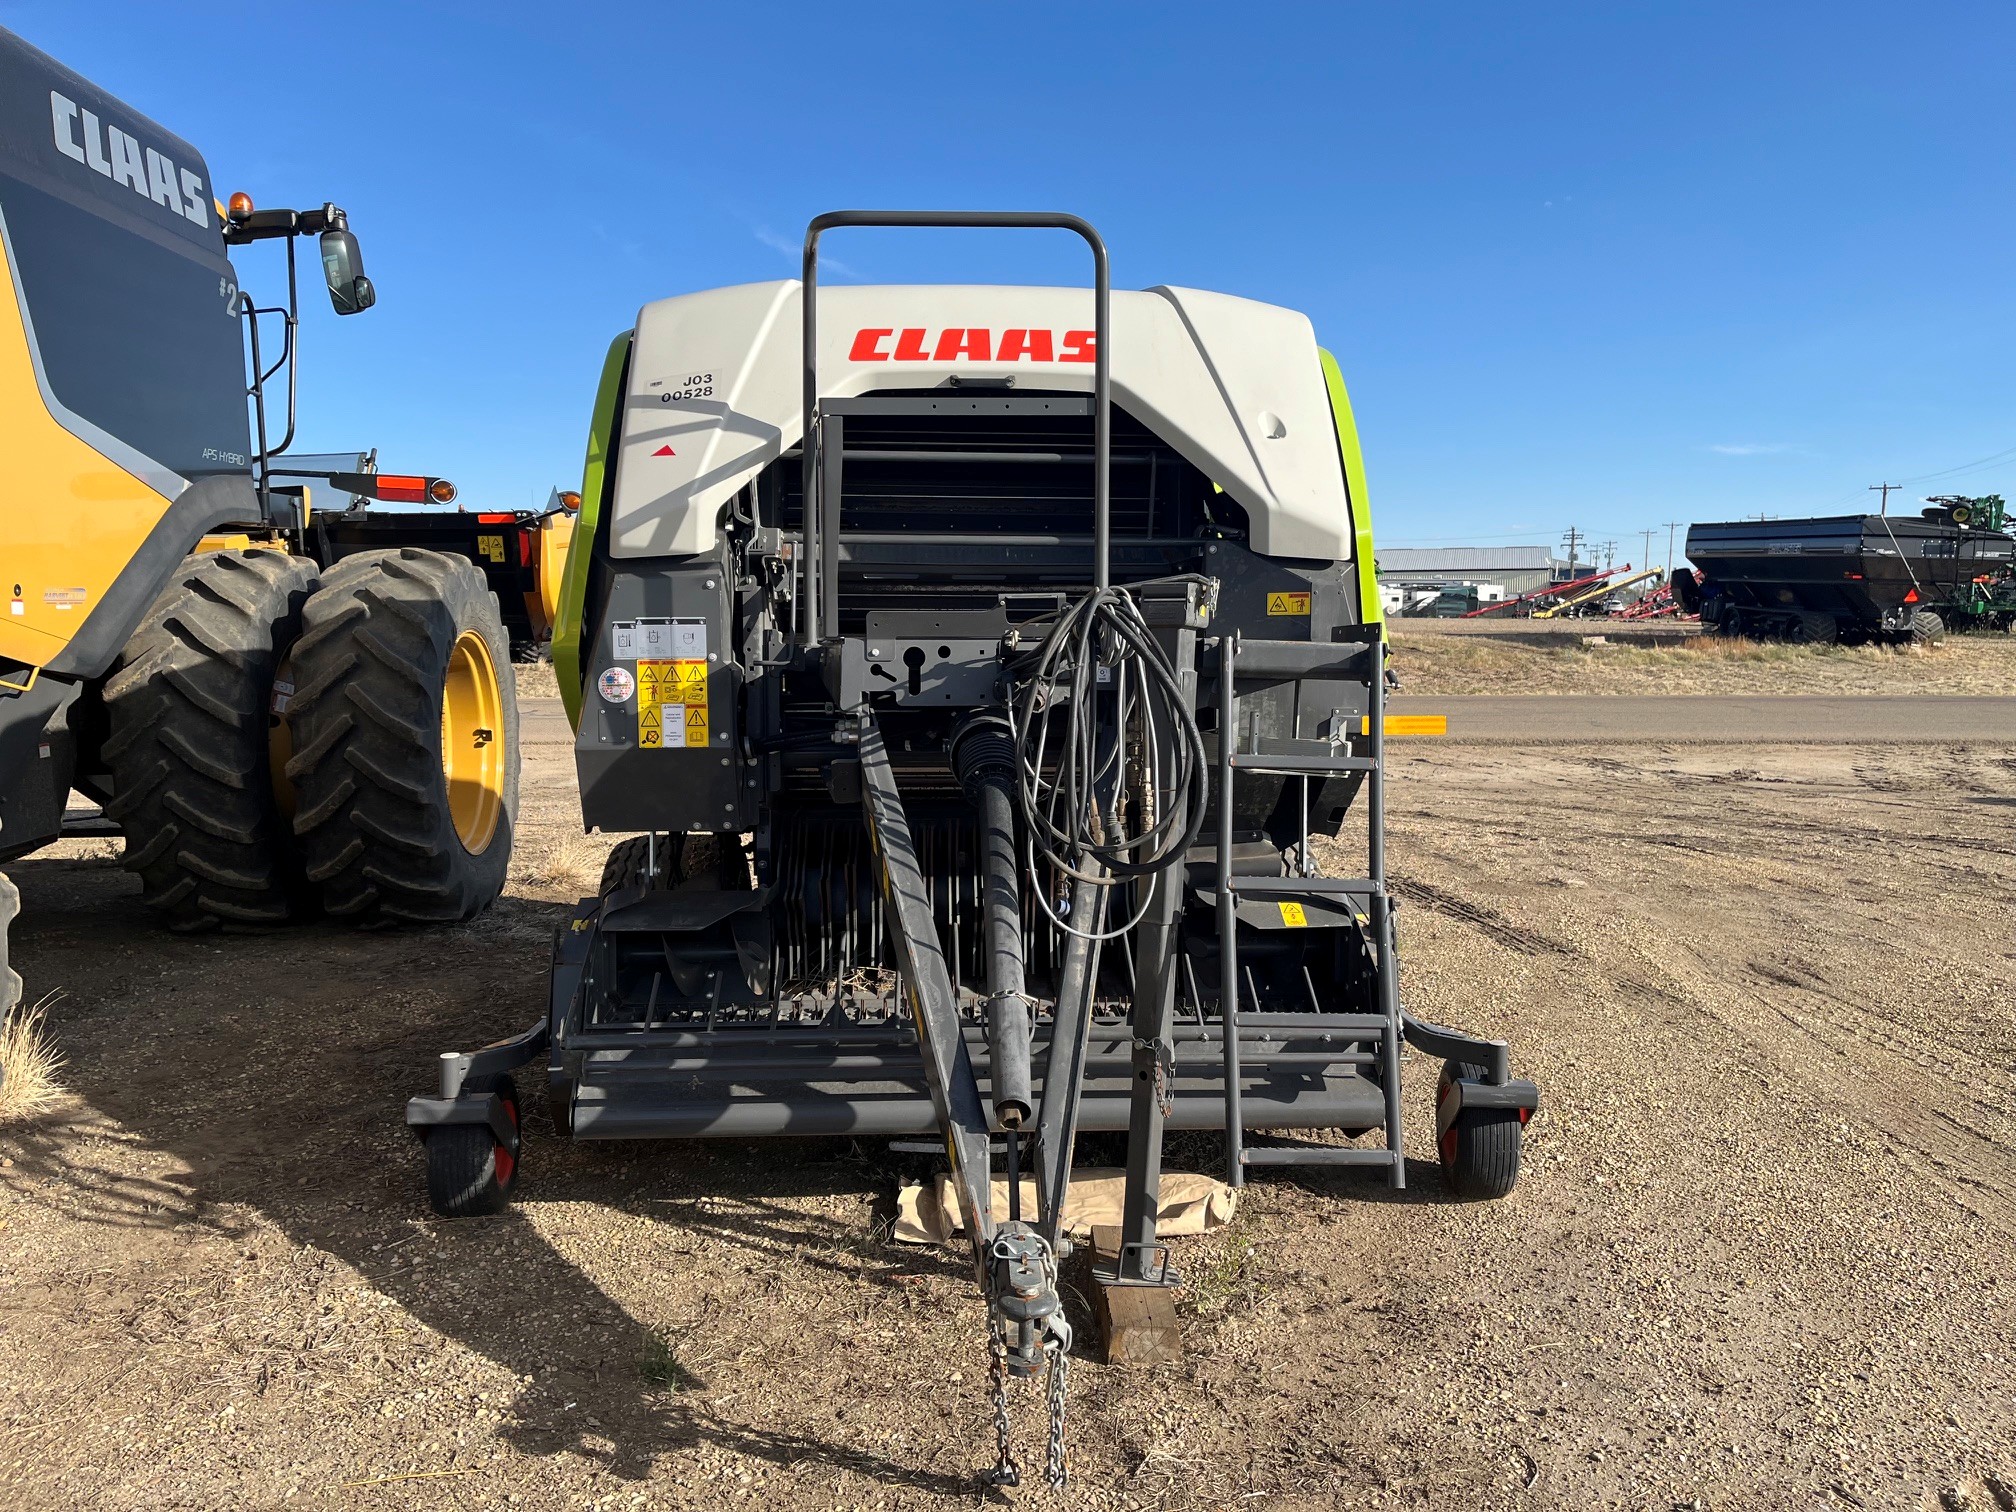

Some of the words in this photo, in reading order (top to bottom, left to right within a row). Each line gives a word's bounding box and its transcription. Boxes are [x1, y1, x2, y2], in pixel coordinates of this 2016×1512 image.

[51, 90, 208, 229] CLAAS
[219, 277, 236, 318] #2
[848, 328, 1096, 363] CLAAS
[661, 386, 713, 402] 00528
[202, 448, 217, 460] APS
[219, 451, 245, 466] HYBRID
